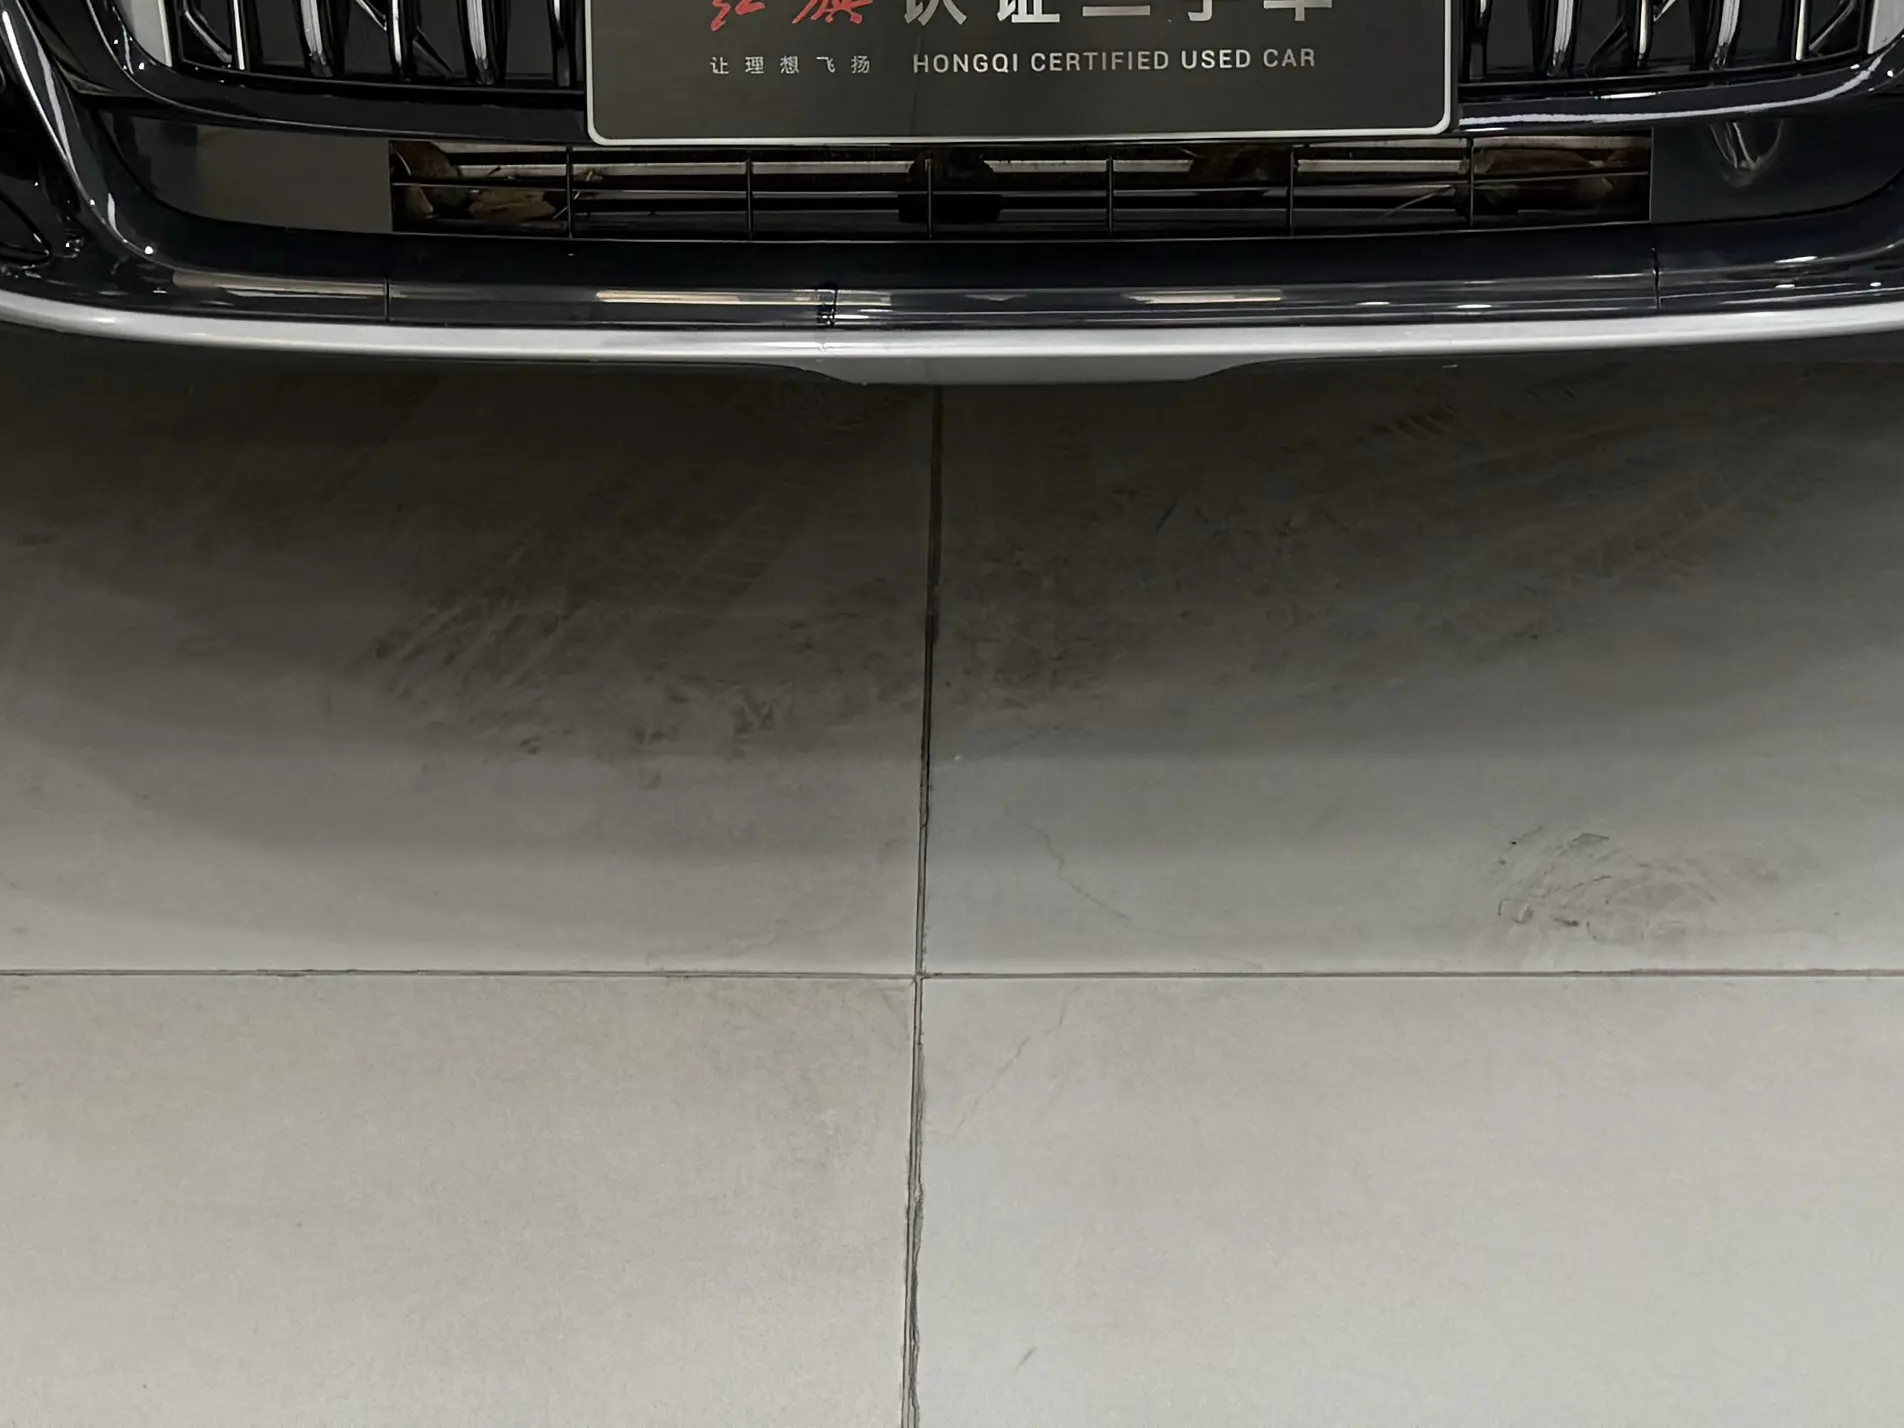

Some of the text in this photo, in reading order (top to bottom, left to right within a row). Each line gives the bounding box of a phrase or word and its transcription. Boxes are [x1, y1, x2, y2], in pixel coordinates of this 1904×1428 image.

[709, 55, 871, 75] 让理想飞扬
[912, 48, 1316, 74] HONGQI CERTIFIED USED CAR
